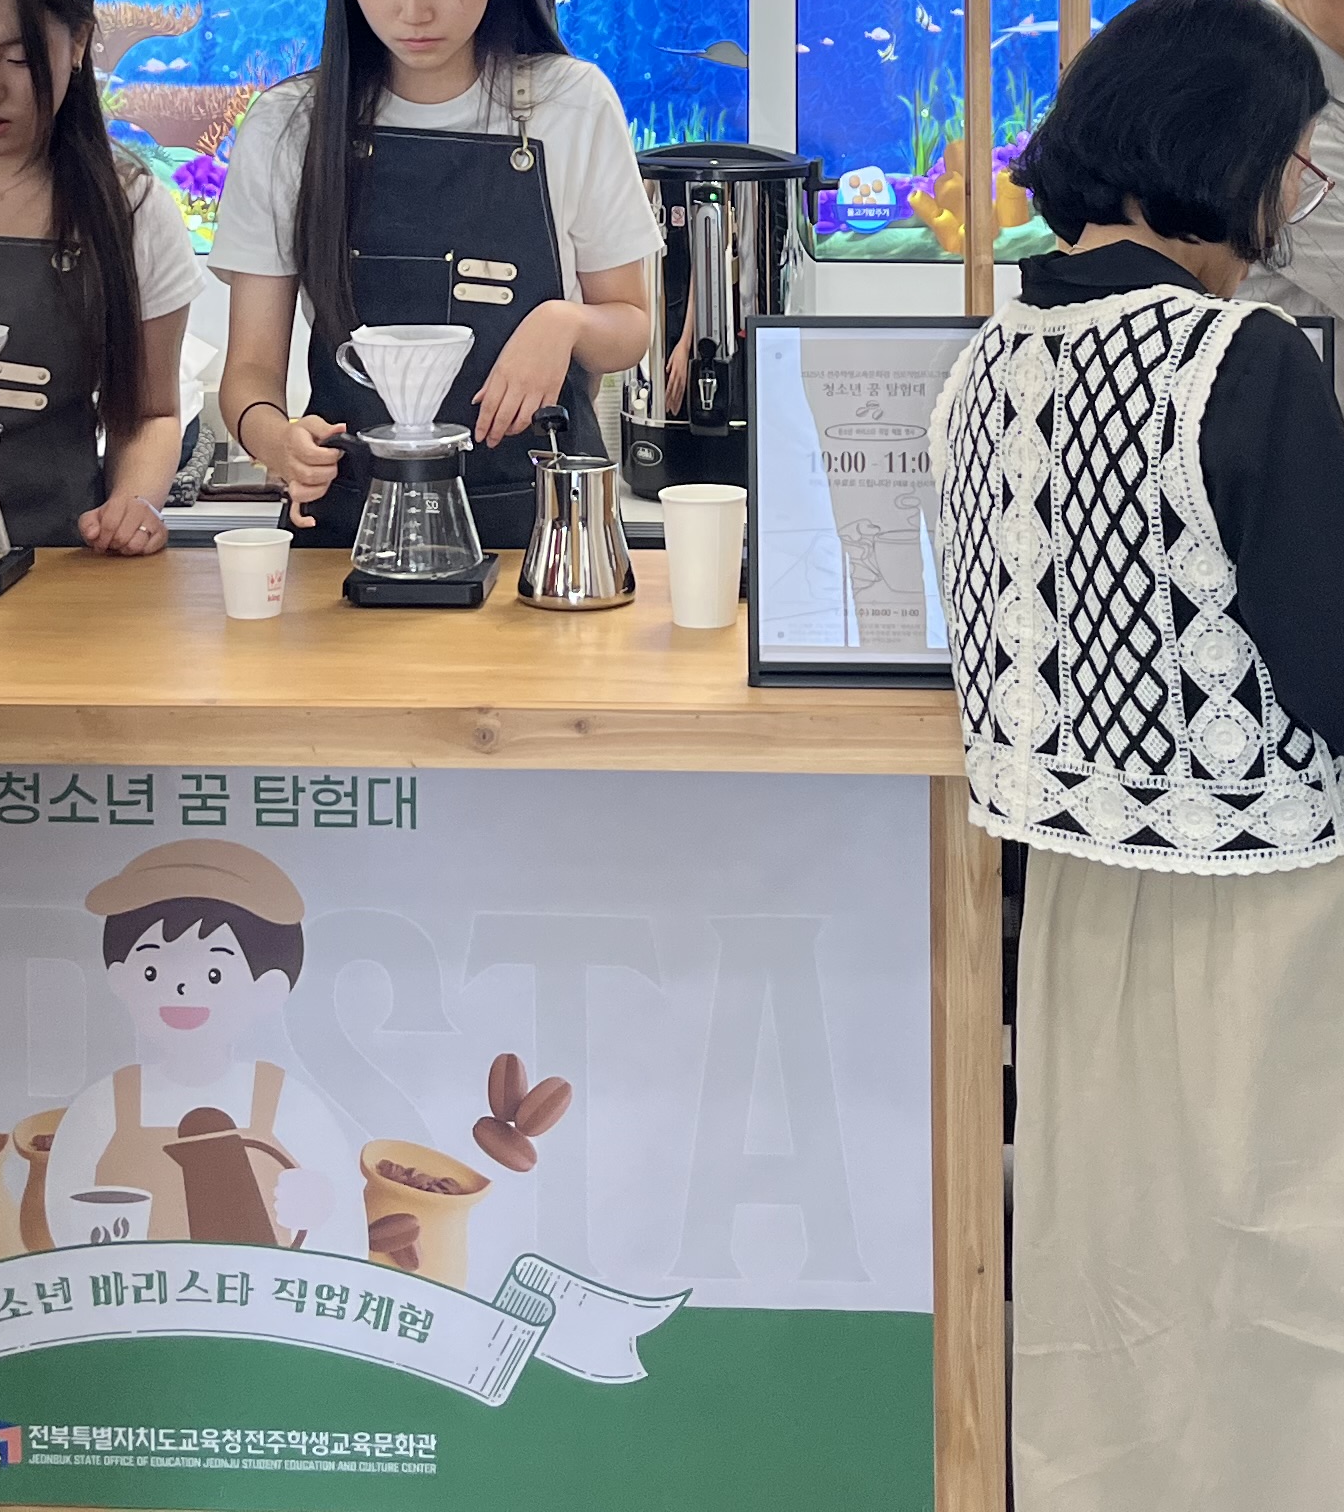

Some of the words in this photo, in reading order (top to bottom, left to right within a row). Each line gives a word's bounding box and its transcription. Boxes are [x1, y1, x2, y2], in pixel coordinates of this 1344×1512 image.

[884, 451, 930, 474] 11:0
[178, 774, 230, 827] 꿈
[253, 774, 427, 830] 탐험대
[89, 1270, 256, 1309] 바리스타
[271, 1276, 435, 1346] 직업체험
[74, 1455, 101, 1466] STATE
[104, 1456, 134, 1467] OFFICE
[137, 1456, 148, 1467] OF
[150, 1456, 201, 1468] EDUCATION
[285, 1460, 336, 1471] EDUCATION
[337, 1461, 356, 1472] AND
[359, 1462, 399, 1473] CULTURE
